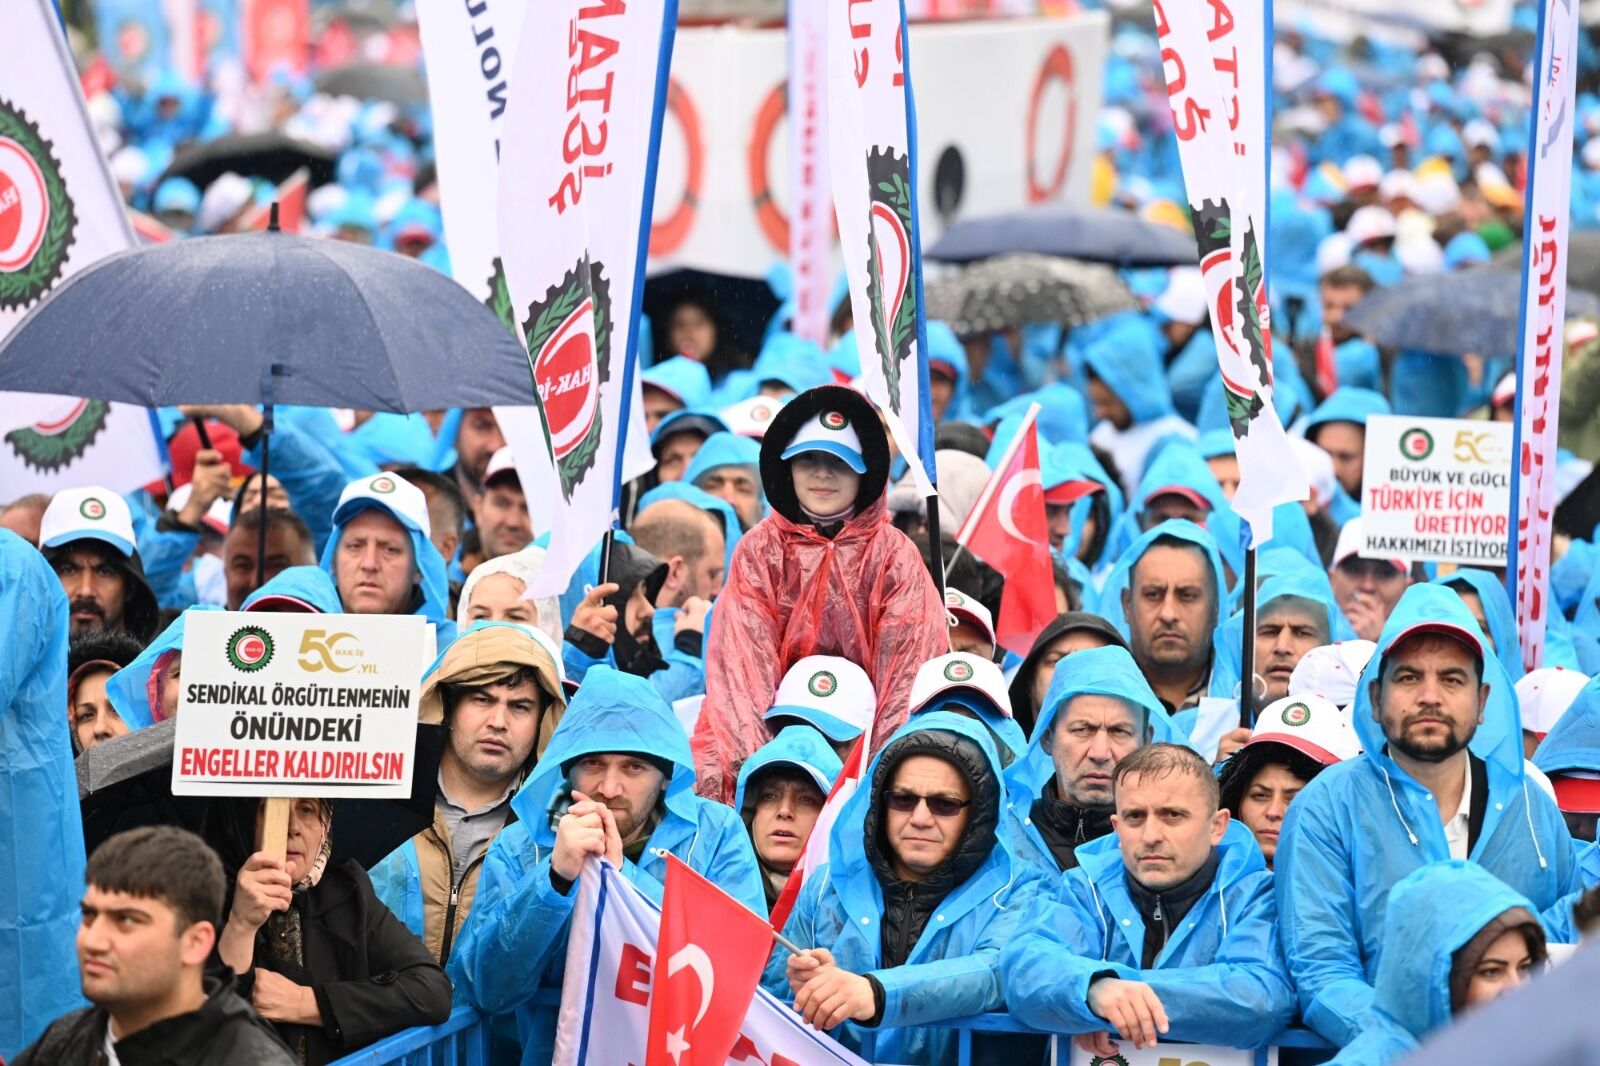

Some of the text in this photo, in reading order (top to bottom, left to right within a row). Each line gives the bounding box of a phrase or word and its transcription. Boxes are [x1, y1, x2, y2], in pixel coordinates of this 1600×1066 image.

[1389, 468, 1509, 487] BÜYÜK VE GÜÇL
[1370, 484, 1484, 511] TÜRKİYE İÇİN
[1415, 512, 1507, 536] ÜRETİYOR
[1366, 536, 1509, 559] HAKKIMIZI İSTİYOR
[298, 629, 360, 673] 50
[186, 681, 411, 708] SENDİKAL ÖRGÜTLENMENİN
[230, 710, 362, 742] ÖNÜNDEKİ
[180, 747, 404, 780] ENGELLER KALDIRILSIN
